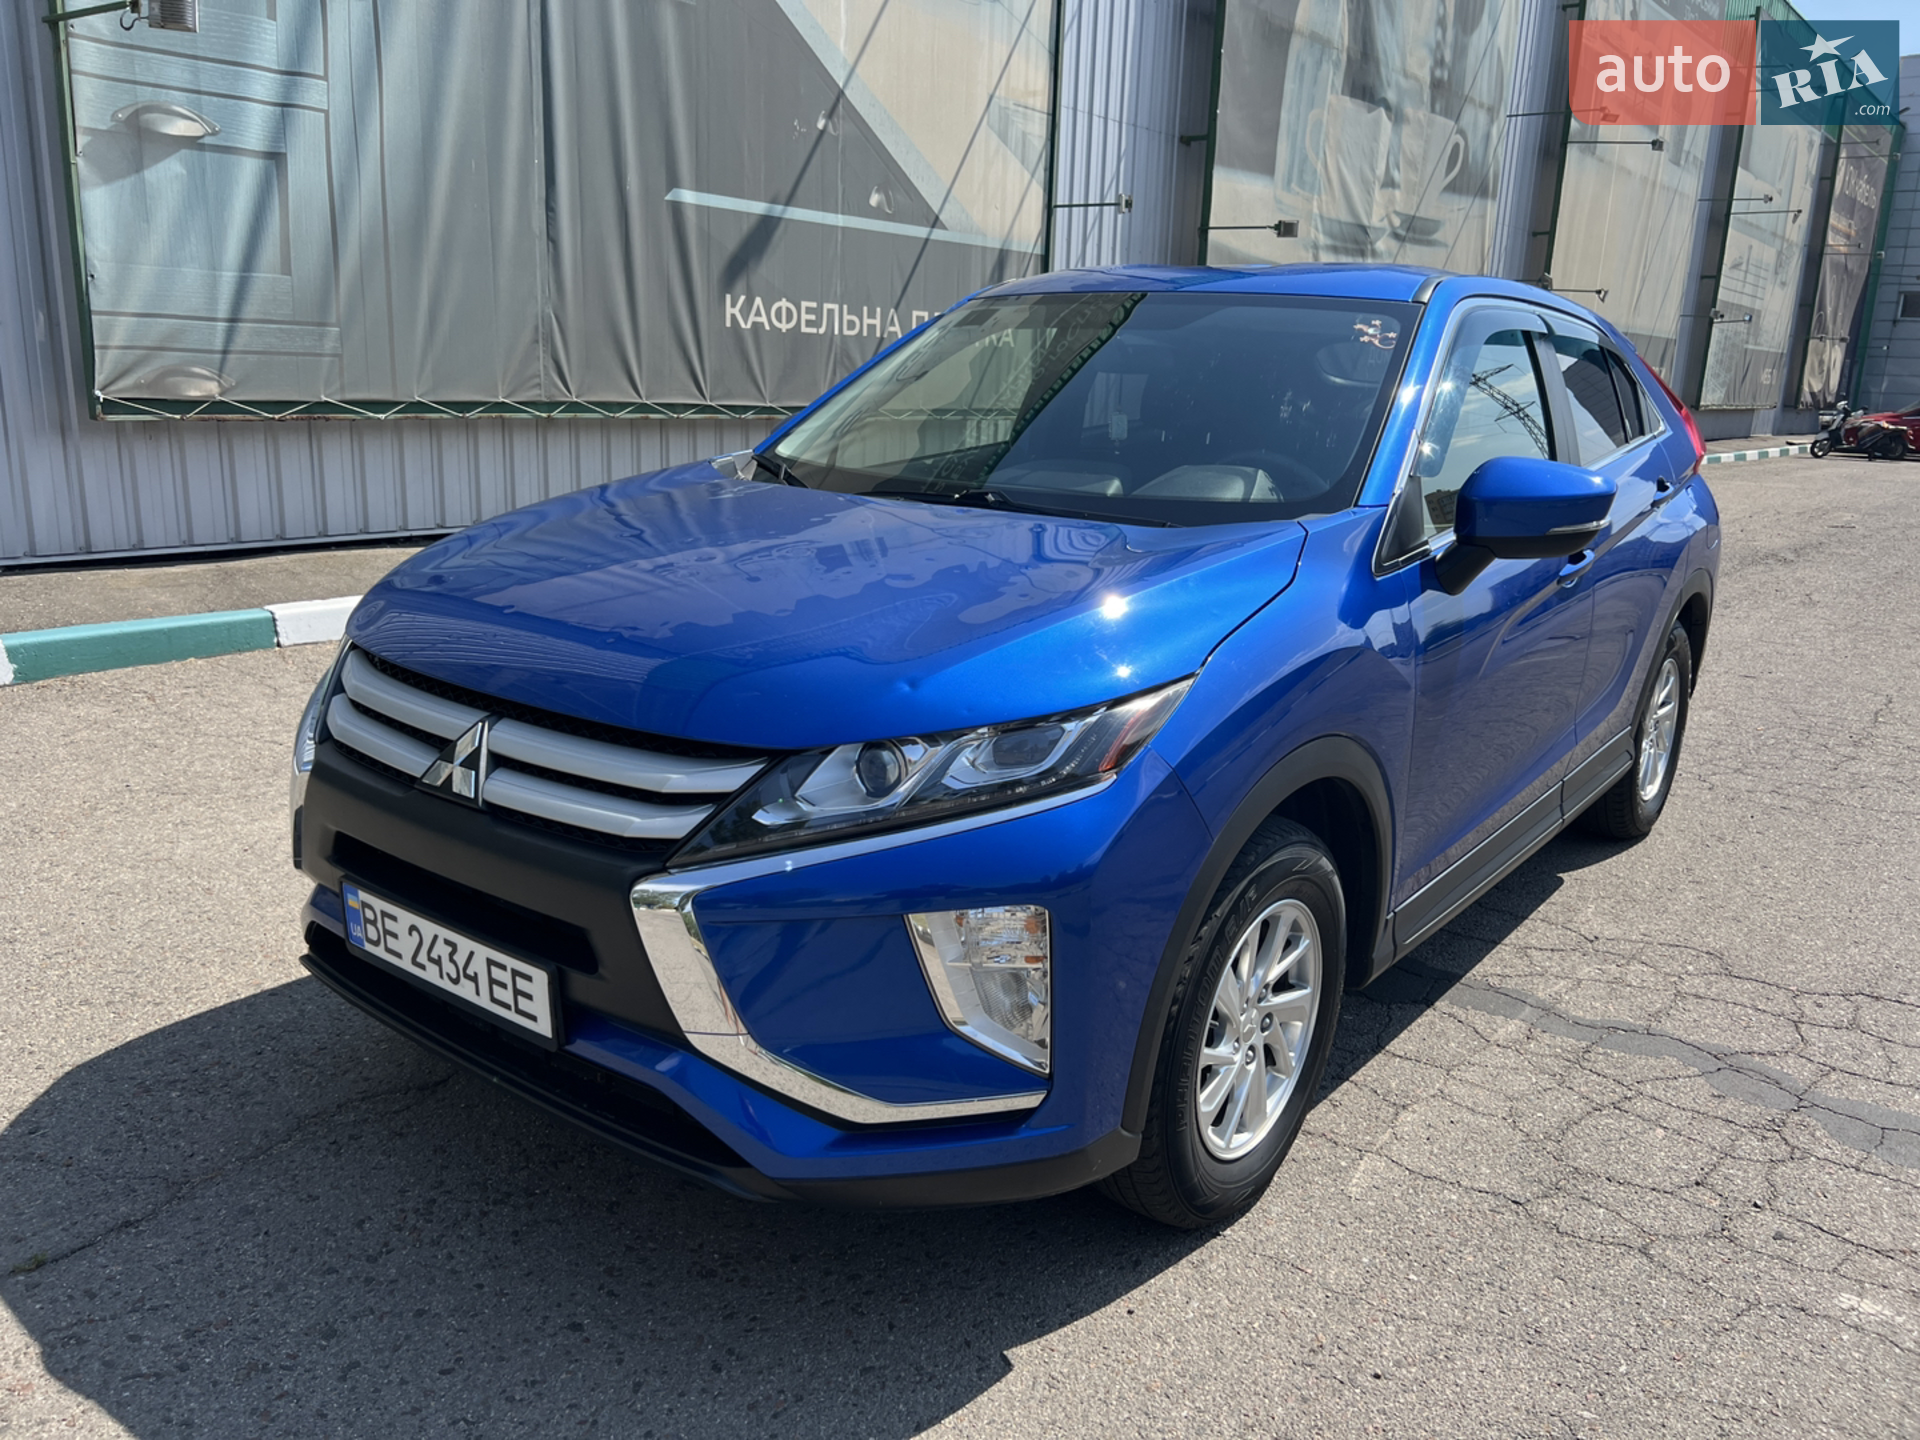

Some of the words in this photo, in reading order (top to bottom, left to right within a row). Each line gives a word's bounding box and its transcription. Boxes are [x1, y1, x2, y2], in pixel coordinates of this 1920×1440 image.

[725, 293, 902, 338] КАФЕЛЬНА
[350, 922, 364, 939] UA
[360, 899, 404, 961] BE
[408, 923, 481, 997] 2434
[486, 956, 538, 1024] EE
